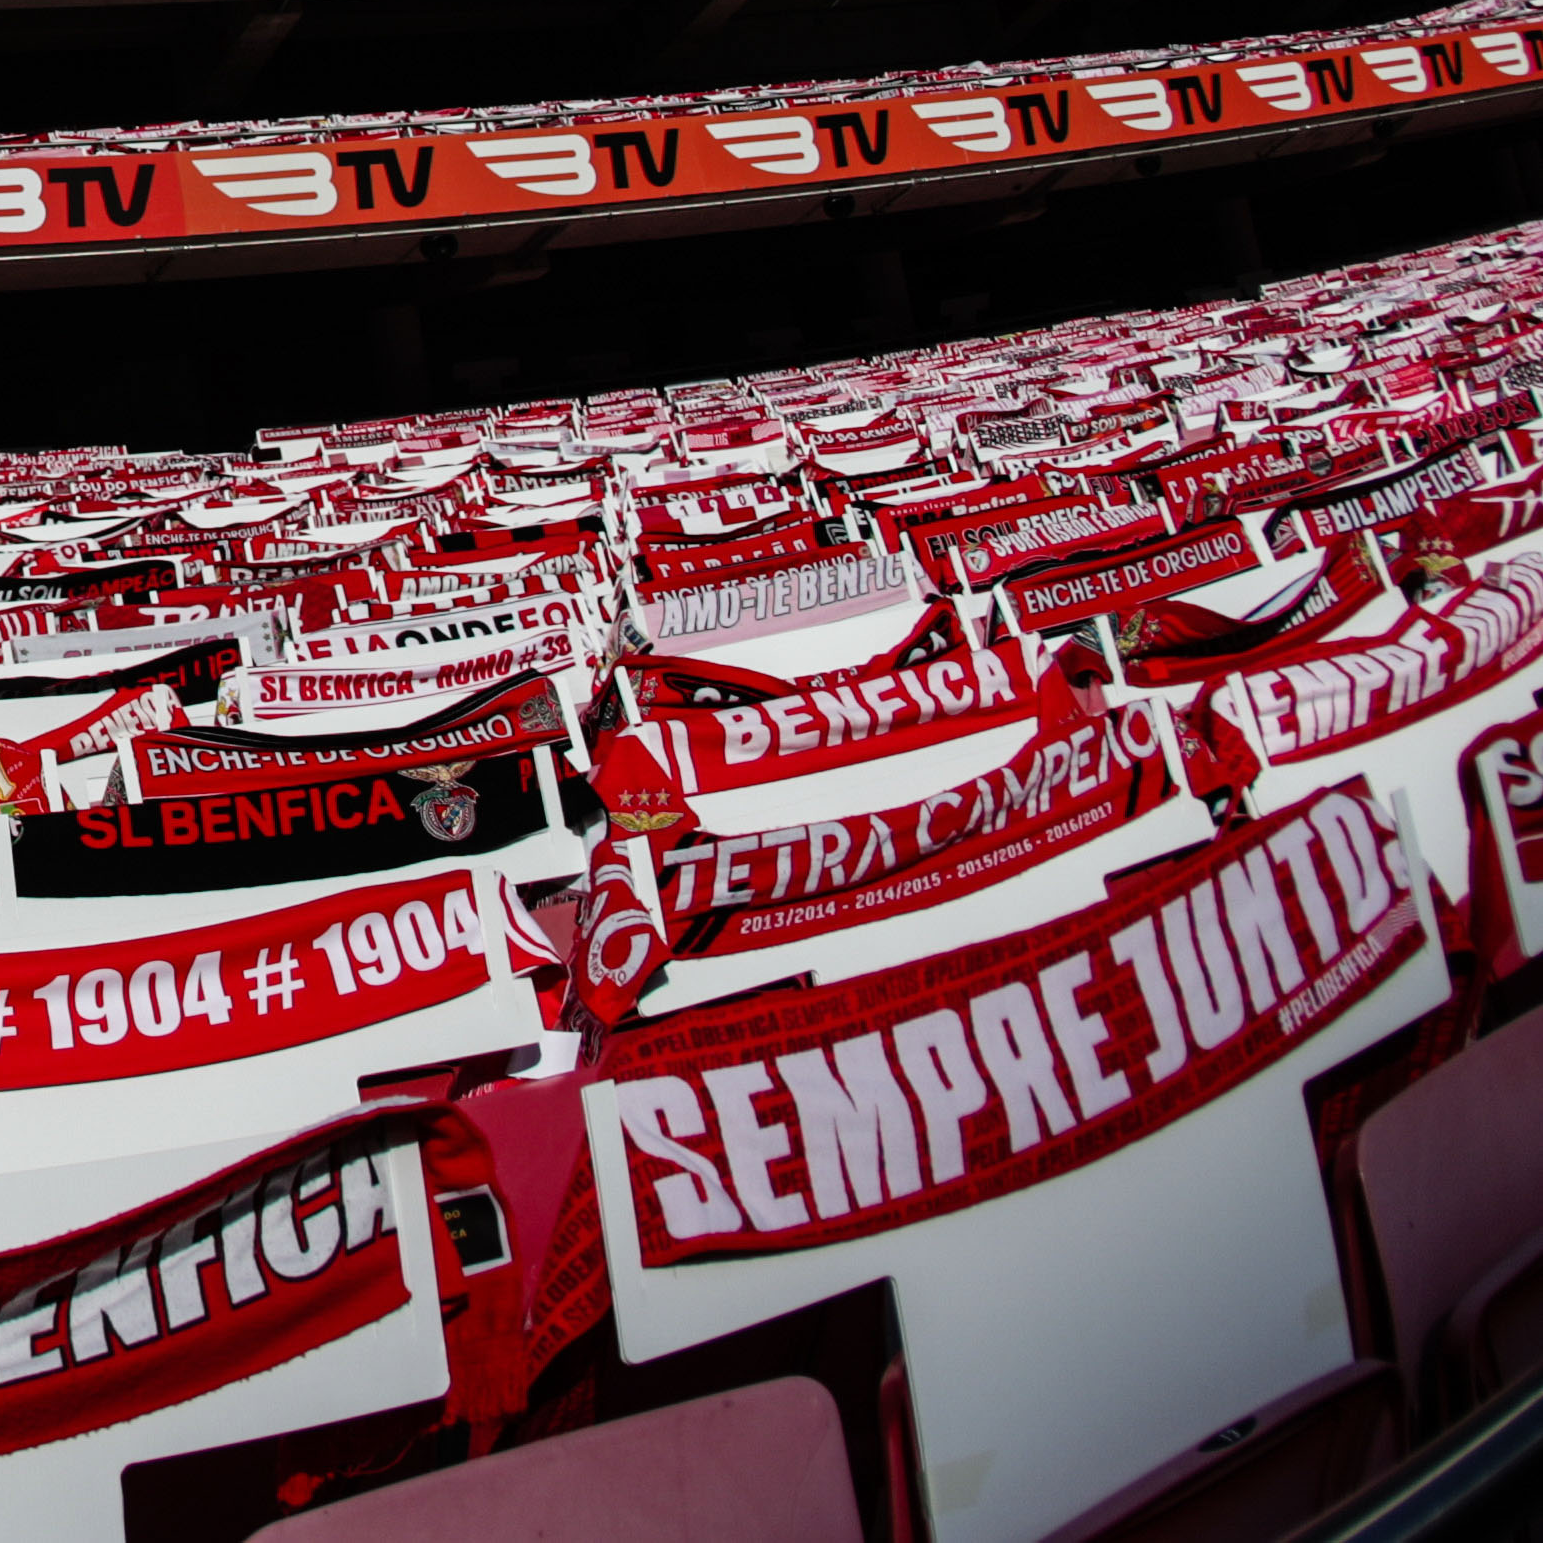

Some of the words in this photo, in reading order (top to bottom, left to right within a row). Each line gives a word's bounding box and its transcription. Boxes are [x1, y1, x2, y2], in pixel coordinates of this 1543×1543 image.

[659, 579, 794, 639] AMO-TE
[1023, 570, 1122, 616] ENCHE-TE
[1128, 564, 1153, 590] DE
[1153, 531, 1243, 583] ORGULHO
[259, 674, 293, 706] SL
[299, 663, 414, 702] BENFICA
[435, 648, 515, 691] RUMO
[542, 632, 574, 666] 38
[713, 647, 1016, 764] BENFICA
[78, 806, 153, 850] SL
[161, 777, 407, 848] BENFICA
[664, 810, 898, 914] TETRA
[740, 903, 837, 935] 2013/2014
[854, 877, 944, 912] 2014/2015
[956, 838, 1036, 878] 2015/2016
[1044, 800, 1114, 846] 2016/2017
[33, 953, 234, 1050] 1904
[244, 945, 306, 1019] #
[313, 888, 487, 996] 1904
[615, 948, 1131, 1242] SEMPRE
